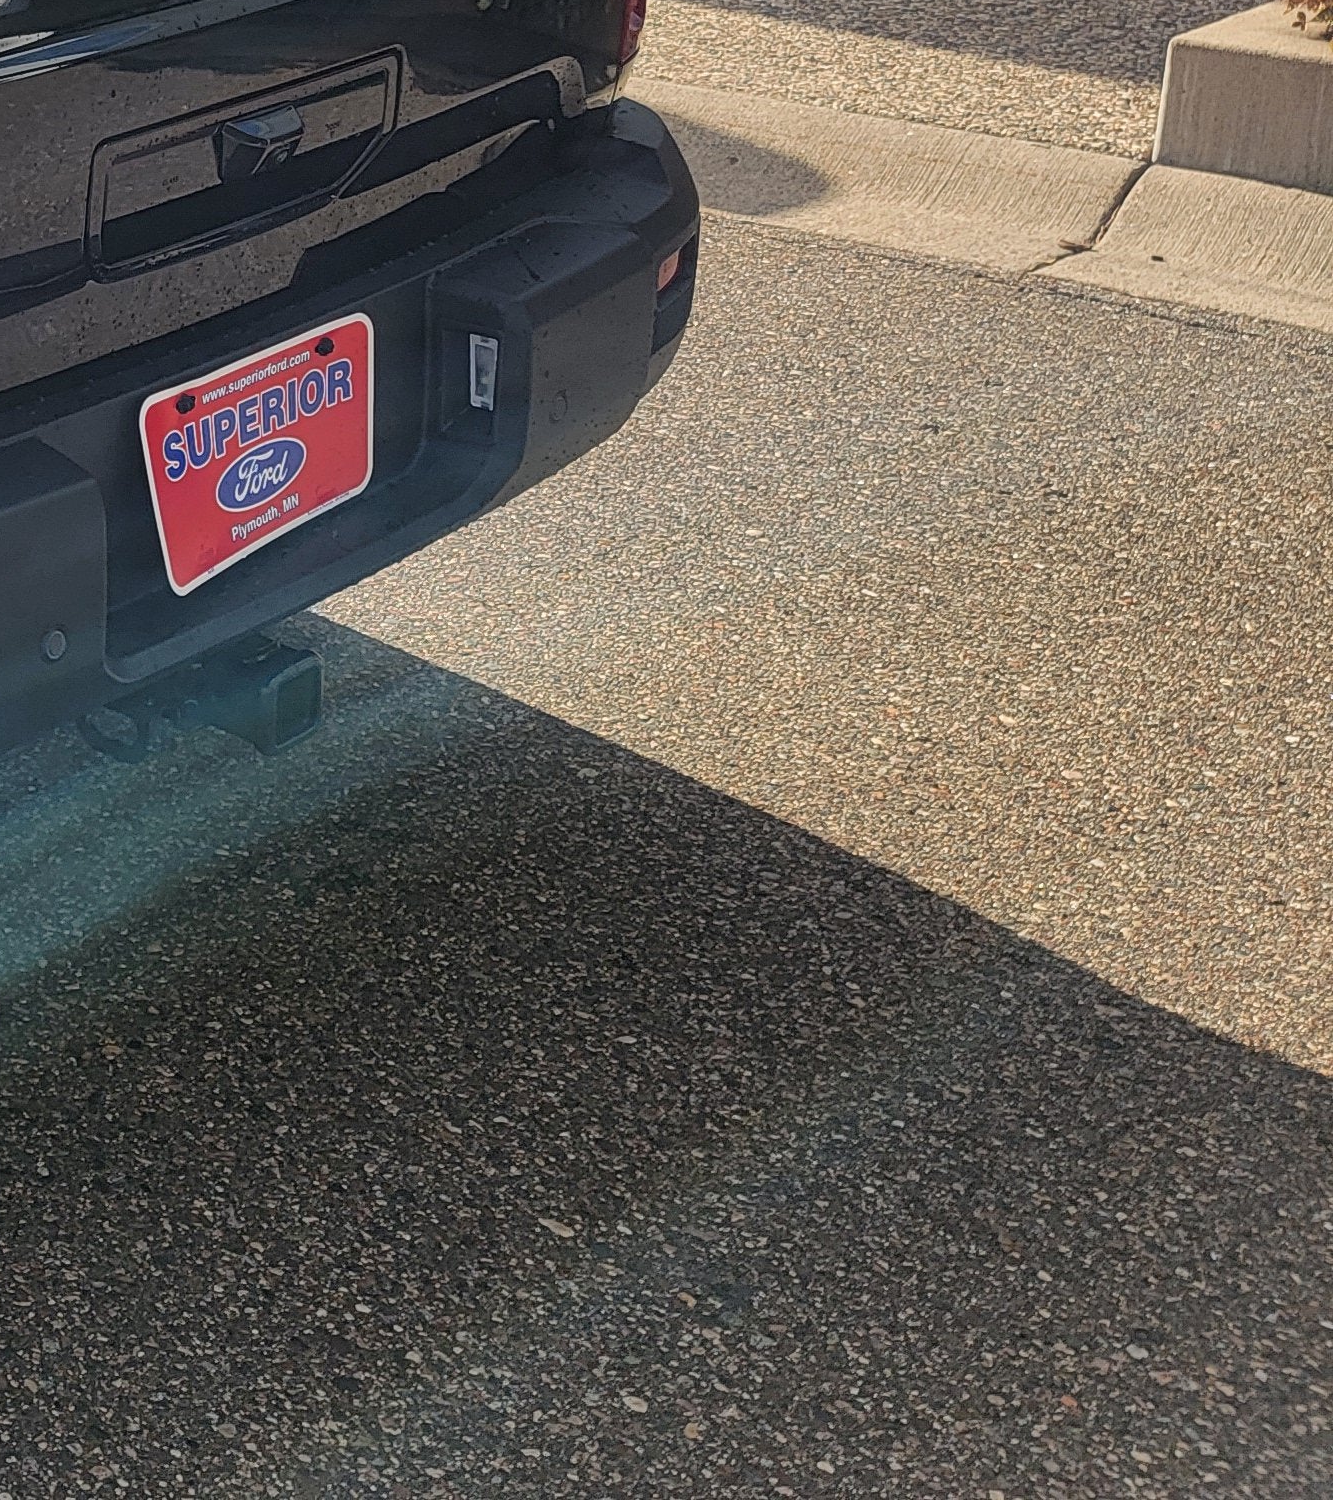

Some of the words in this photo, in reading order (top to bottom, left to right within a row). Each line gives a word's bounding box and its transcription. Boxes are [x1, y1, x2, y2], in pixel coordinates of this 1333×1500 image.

[201, 350, 311, 405] www.superiorford.com
[162, 357, 353, 482] SUPERIOR
[234, 448, 289, 502] Ford
[230, 506, 282, 542] Plymouth,
[282, 493, 300, 515] MN
